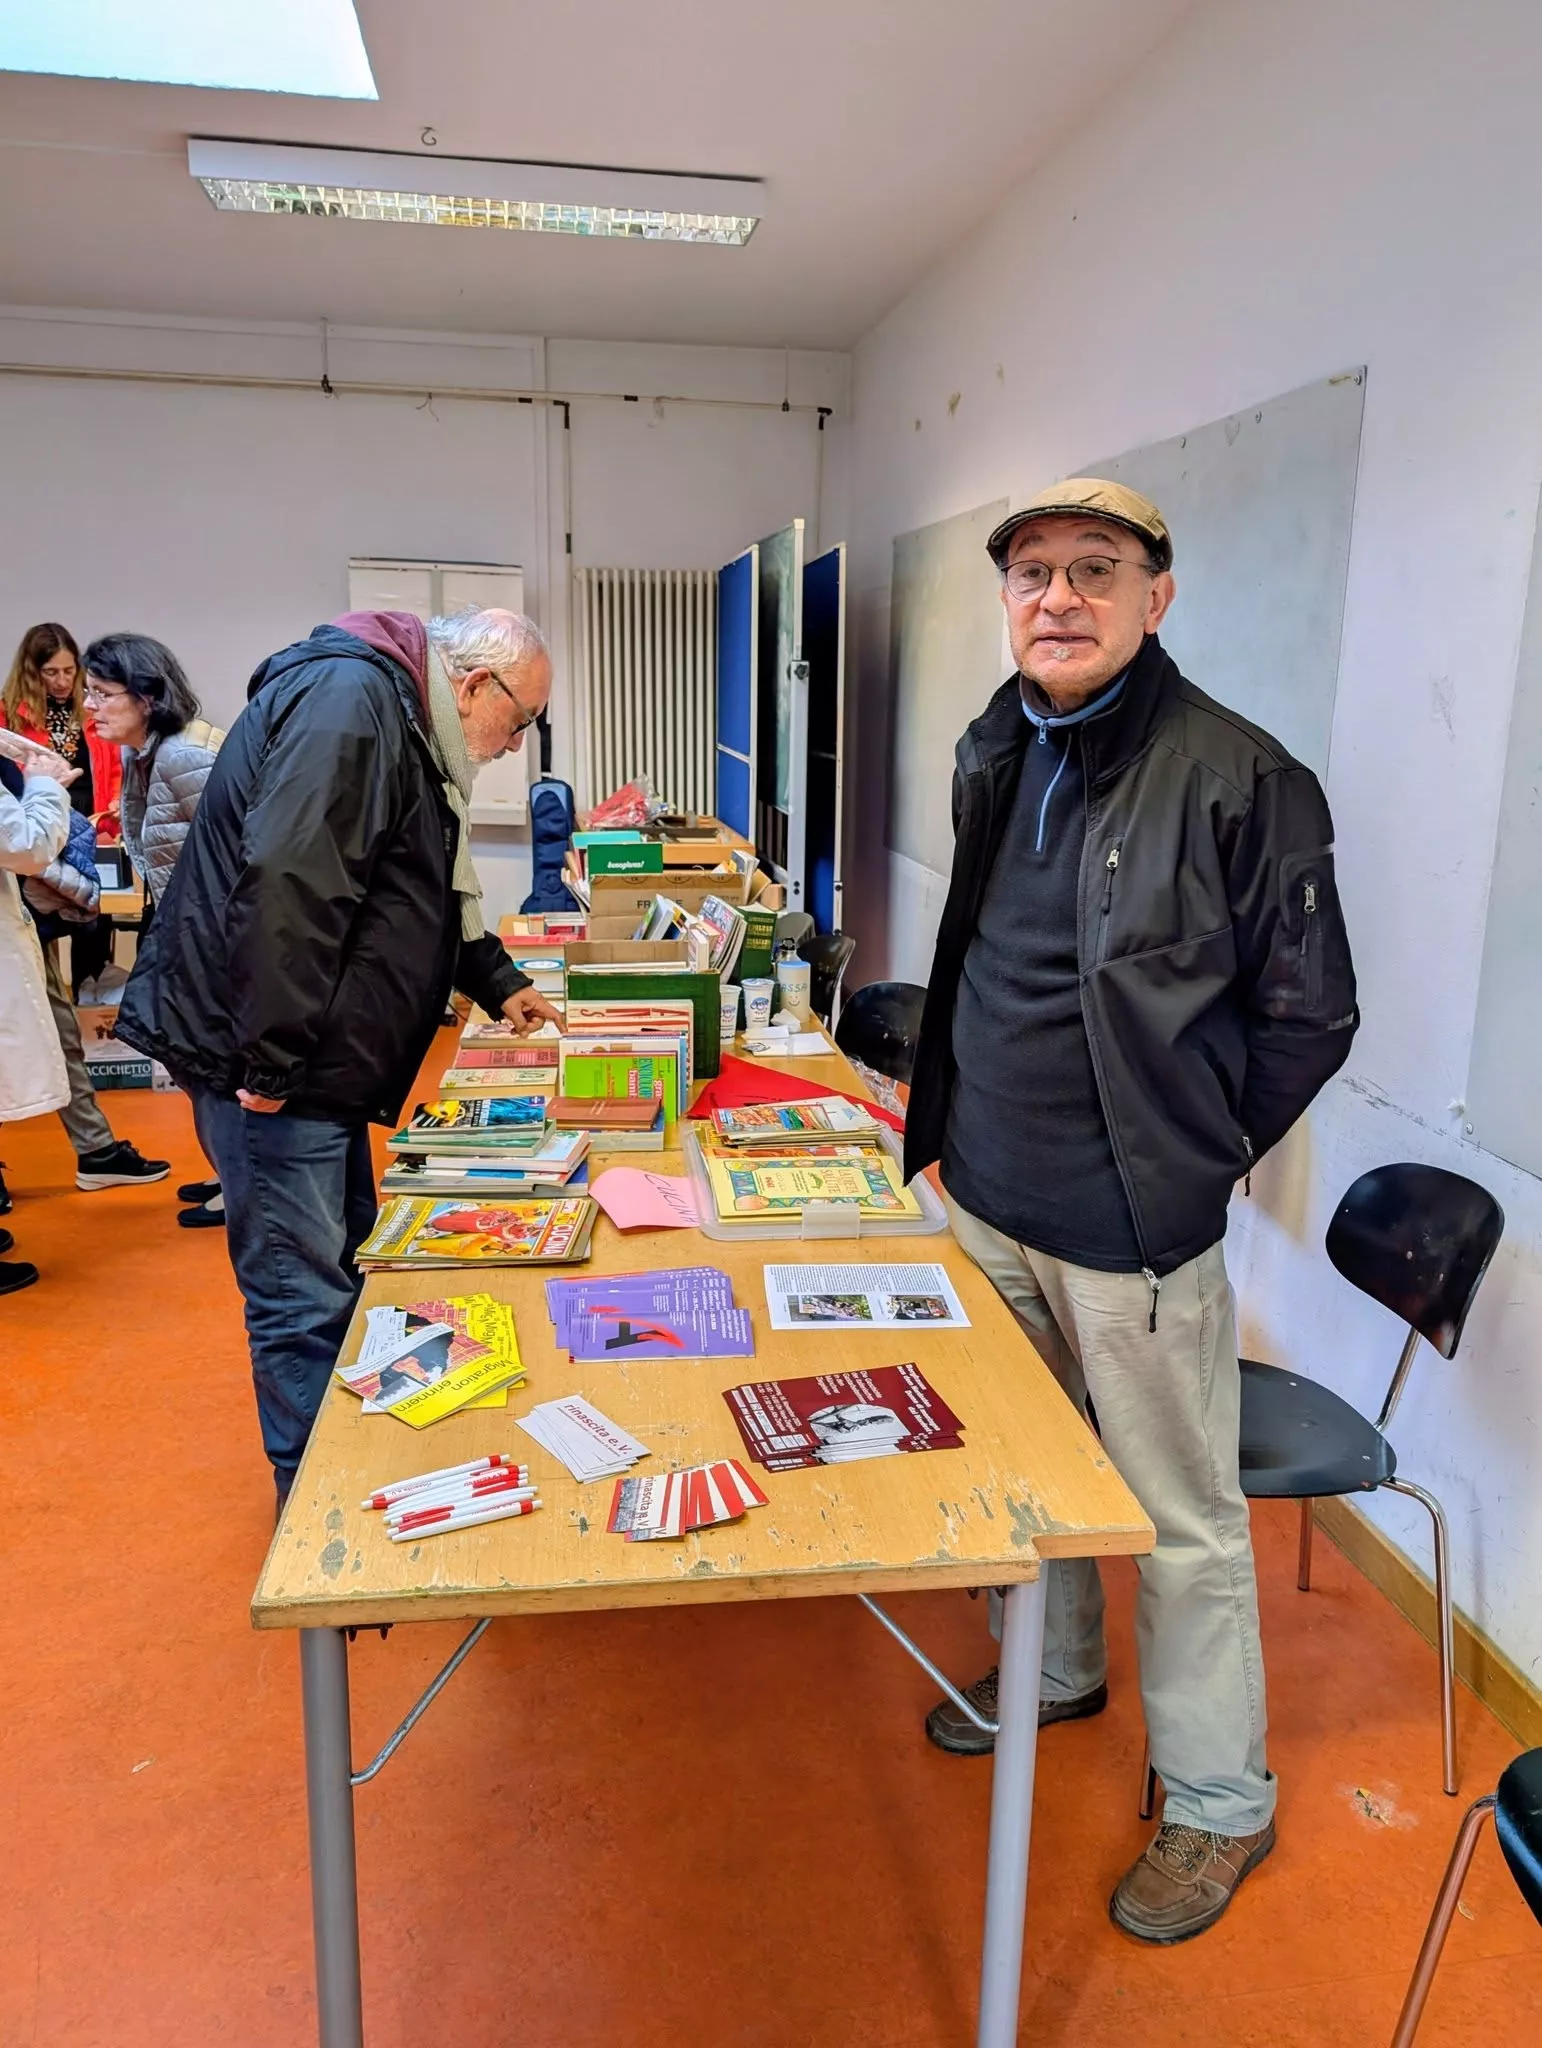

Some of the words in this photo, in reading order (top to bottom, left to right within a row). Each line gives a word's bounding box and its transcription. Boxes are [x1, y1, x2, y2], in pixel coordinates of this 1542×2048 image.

[644, 1174, 700, 1222] CUCINA
[543, 1224, 574, 1255] CUCINA
[452, 1359, 514, 1392] Migration
[396, 1380, 452, 1412] erinnern
[564, 1404, 610, 1437] rinascita
[618, 1444, 632, 1454] V.
[640, 1477, 656, 1511] rinascita
